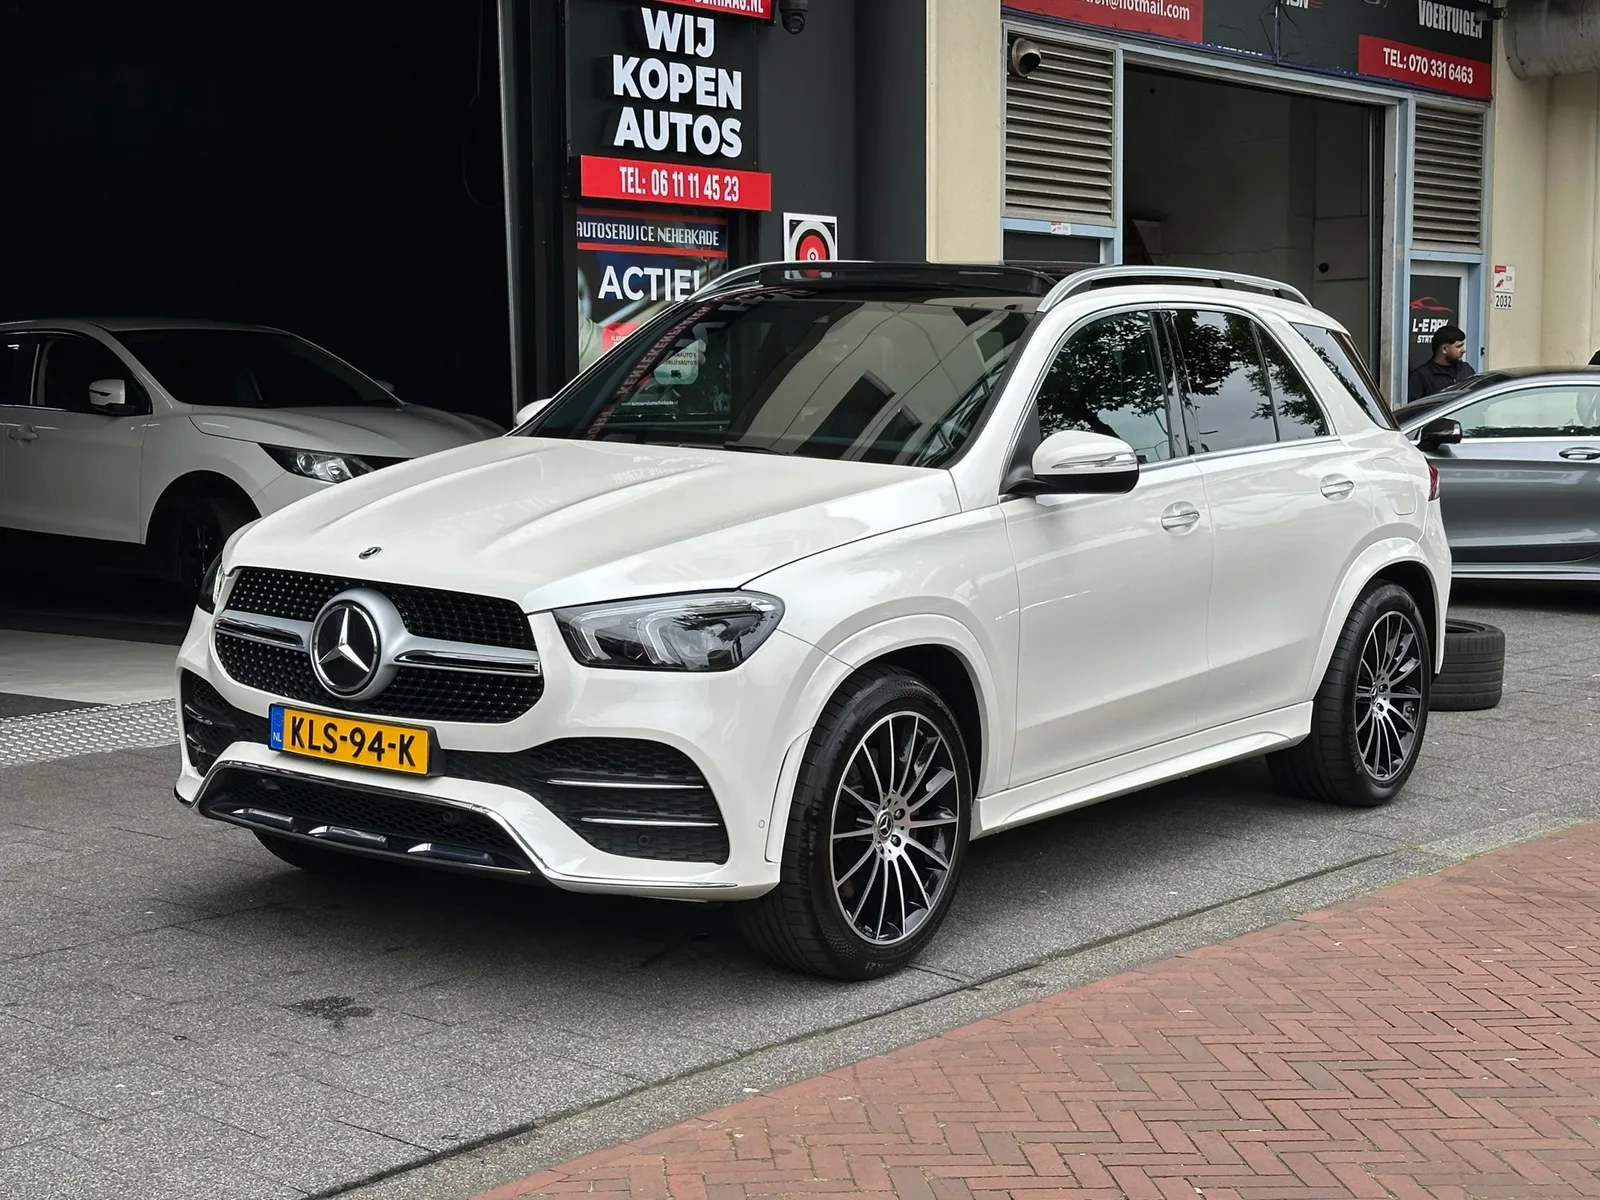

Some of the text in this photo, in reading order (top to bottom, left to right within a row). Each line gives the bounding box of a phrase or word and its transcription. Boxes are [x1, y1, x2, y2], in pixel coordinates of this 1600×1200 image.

[641, 7, 714, 58] WIJ
[613, 54, 742, 110] KOPEN
[1383, 47, 1473, 85] TEL: 070 331 6463
[613, 106, 743, 158] AUTOS
[619, 166, 740, 202] TEL: 06 11 11 45 23
[576, 221, 720, 246] AUTOSERVICE NEHERKADE
[1495, 294, 1512, 308] 2032
[273, 716, 416, 767] NL KLS-94-K
